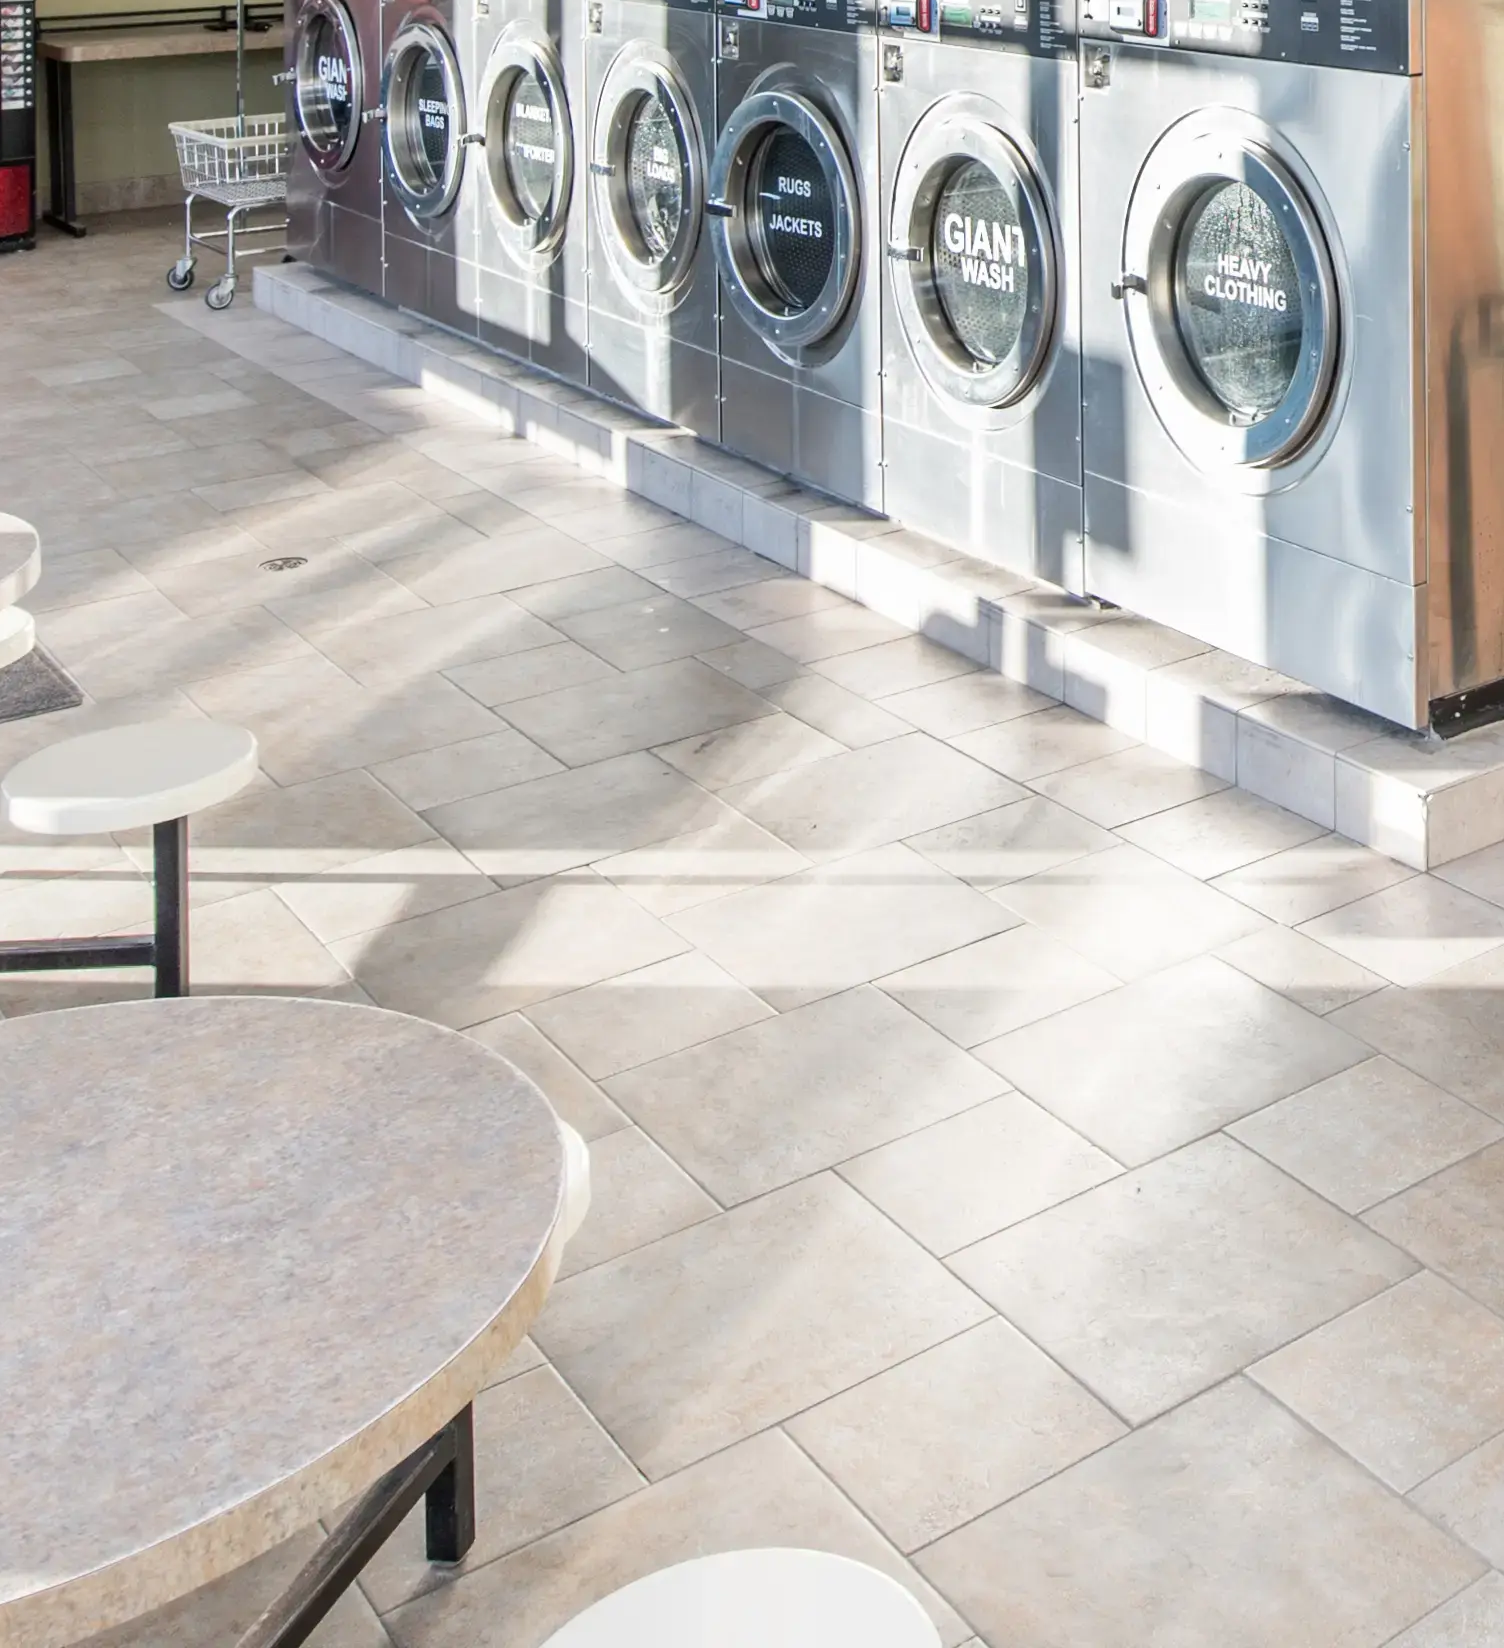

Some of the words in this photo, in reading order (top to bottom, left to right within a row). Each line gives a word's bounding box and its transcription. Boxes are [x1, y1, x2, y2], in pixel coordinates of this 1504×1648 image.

[318, 55, 347, 84] GIAN
[425, 114, 445, 130] BAGS
[516, 102, 552, 123] BLANKET
[646, 161, 676, 184] LOADS
[778, 176, 812, 198] RUGS
[769, 213, 823, 238] JACKETS
[944, 213, 1026, 268] GIANT
[960, 256, 1015, 293] WASH
[1217, 252, 1273, 285] HEAVY
[1204, 274, 1287, 312] CLOTHING
